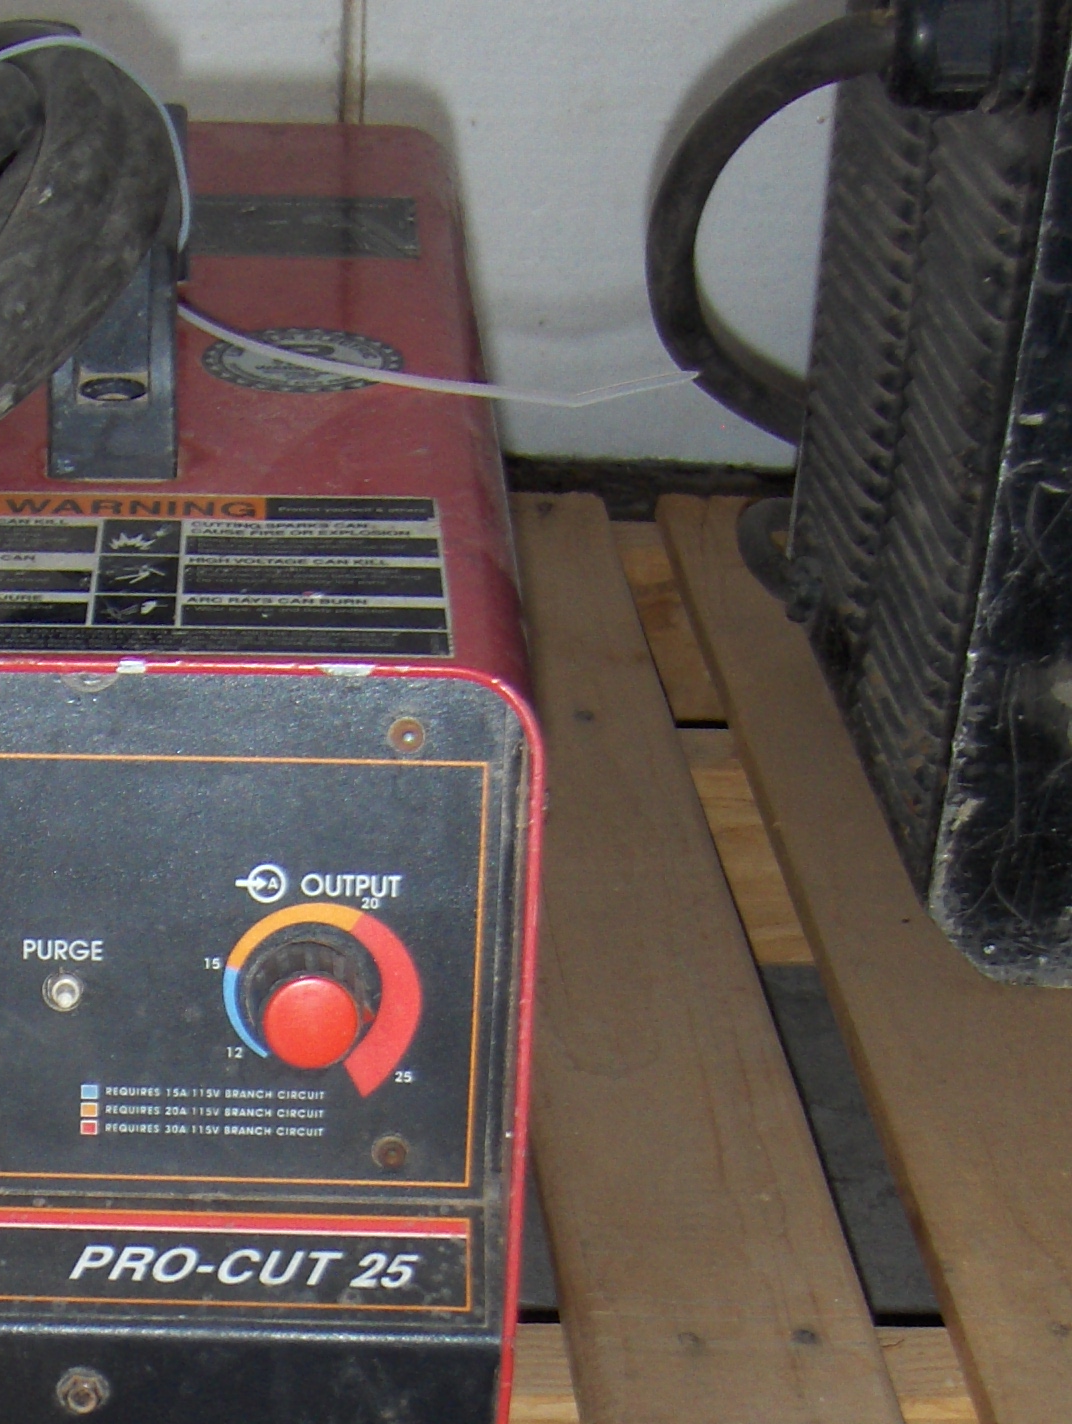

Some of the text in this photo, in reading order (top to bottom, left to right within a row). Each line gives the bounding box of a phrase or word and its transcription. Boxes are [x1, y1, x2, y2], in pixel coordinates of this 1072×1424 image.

[5, 499, 257, 518] WARNING
[191, 521, 261, 529] CUTTING
[1, 554, 36, 562] CAN
[189, 557, 230, 565] HIGH
[228, 597, 272, 605] RAYS
[319, 598, 368, 606] BURN
[300, 873, 402, 898] OUTPUT
[361, 897, 379, 910] 20
[22, 939, 104, 962] PURGE
[204, 957, 221, 970] 15
[227, 1047, 244, 1059] 12
[394, 1071, 413, 1084] 25
[105, 1086, 326, 1101] REQUIRES 15A 115V BRANCH CIRCUIT
[104, 1104, 326, 1119] REQUIRES 20A 115V BRANCH CIRCUIT
[104, 1122, 325, 1137] REQUIRES 30A 115V BRANCH CIRCUIT
[69, 1245, 420, 1288] PRO-CUT 25
